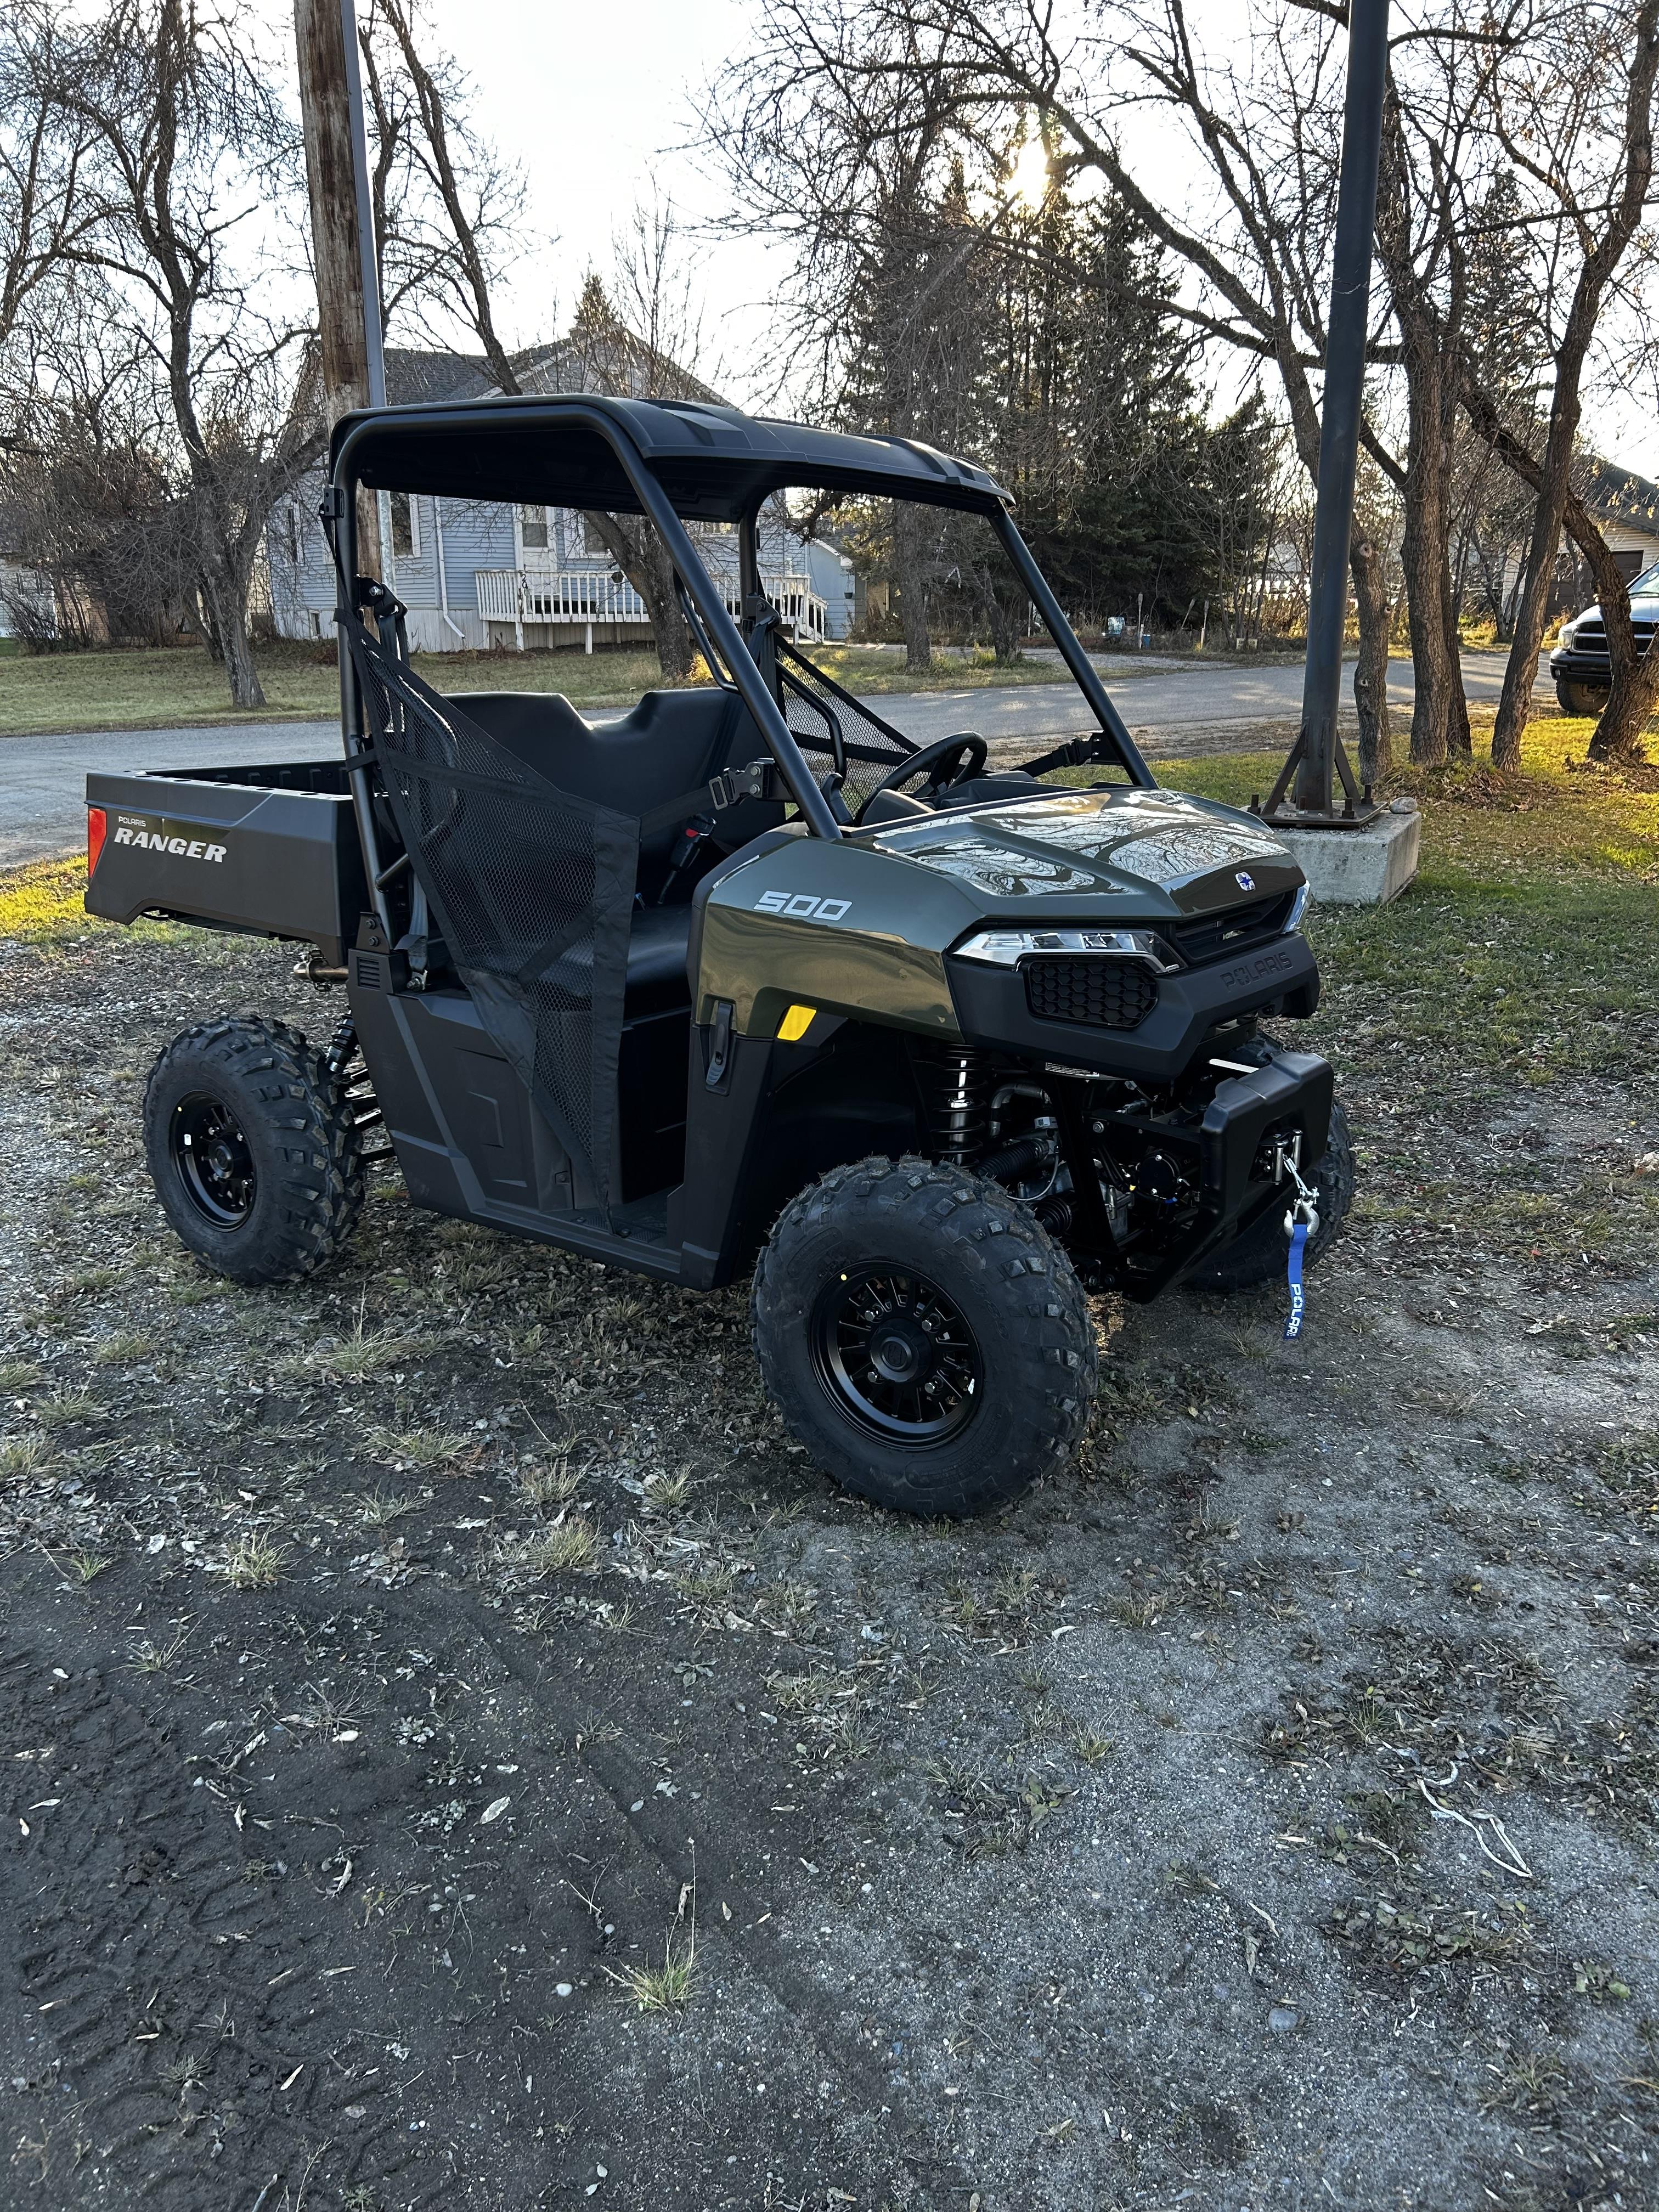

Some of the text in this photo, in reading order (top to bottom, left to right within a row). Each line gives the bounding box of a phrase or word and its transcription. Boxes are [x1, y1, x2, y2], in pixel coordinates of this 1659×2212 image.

[117, 816, 146, 827] POLARIS
[114, 827, 227, 863] RANGER
[753, 890, 853, 921] 500
[1220, 951, 1294, 989] POLARIS
